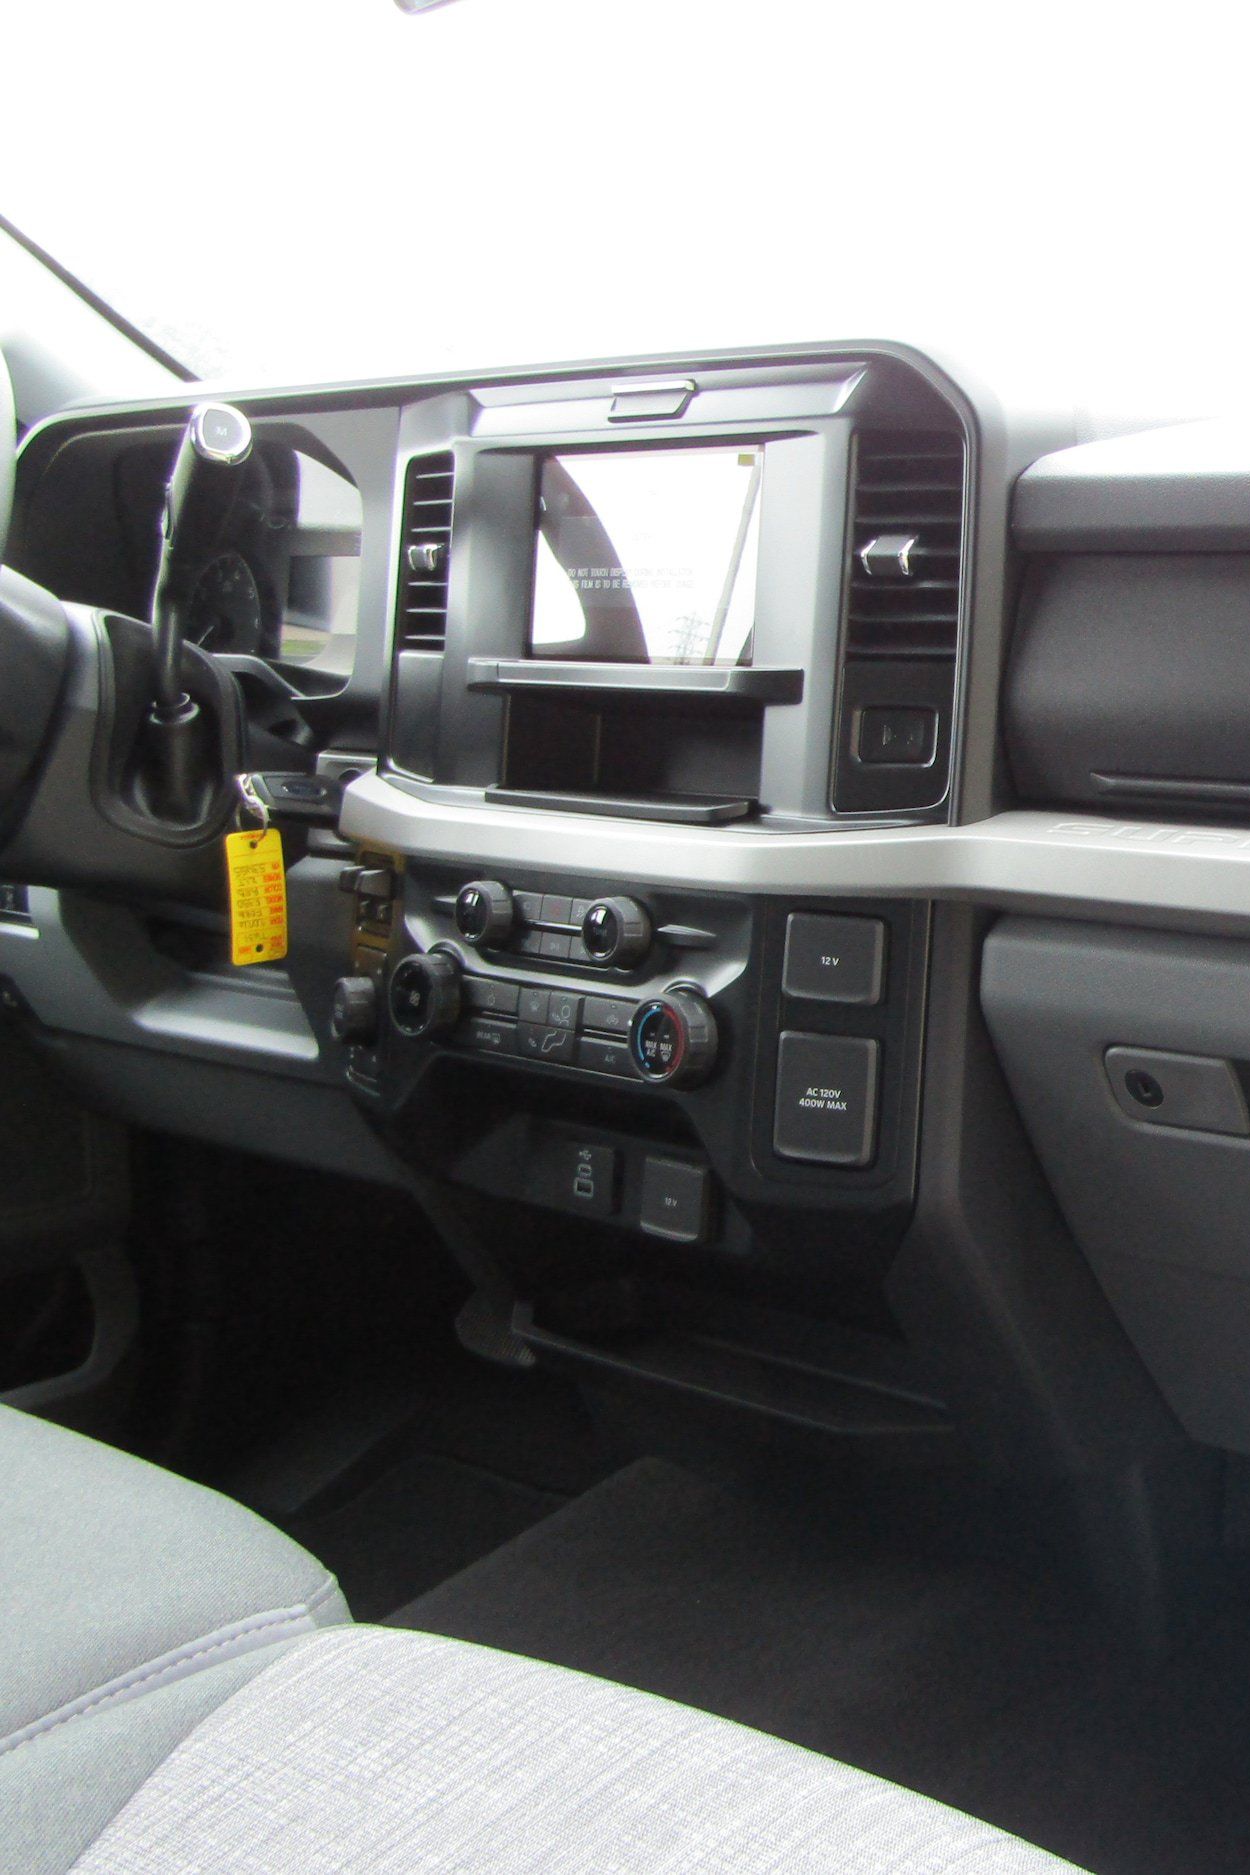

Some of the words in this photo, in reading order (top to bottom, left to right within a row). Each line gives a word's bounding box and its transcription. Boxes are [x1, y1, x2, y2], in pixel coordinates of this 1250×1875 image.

[821, 956, 831, 966] 12
[832, 957, 840, 966] V
[806, 1087, 818, 1097] AC
[820, 1089, 841, 1099] 120V
[799, 1098, 825, 1109] 400W
[826, 1100, 847, 1111] MAX
